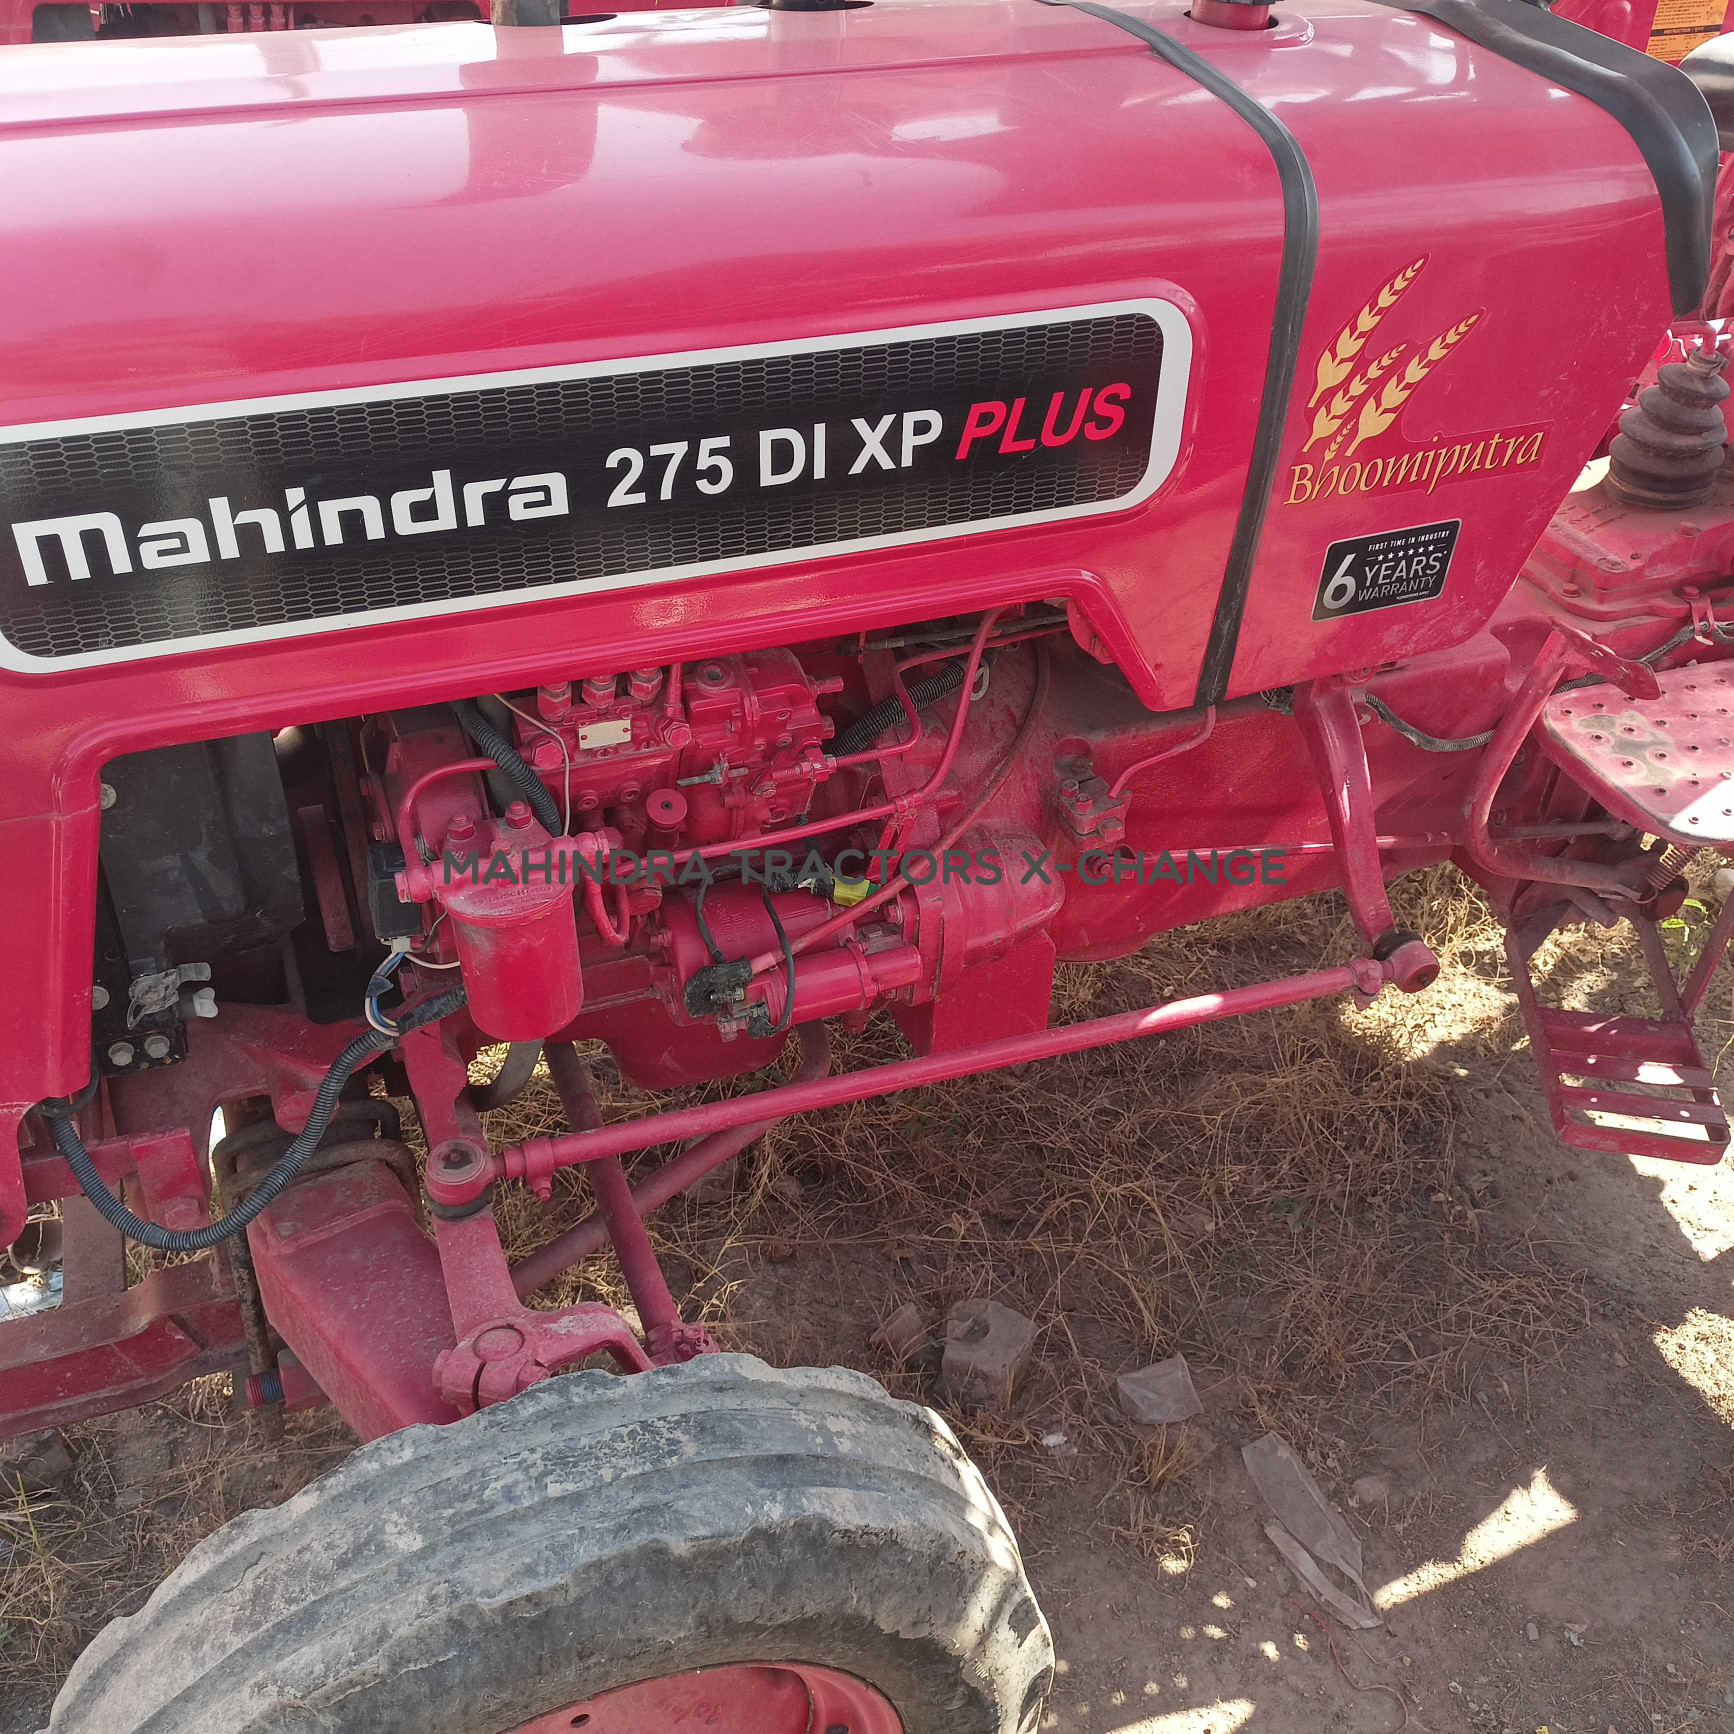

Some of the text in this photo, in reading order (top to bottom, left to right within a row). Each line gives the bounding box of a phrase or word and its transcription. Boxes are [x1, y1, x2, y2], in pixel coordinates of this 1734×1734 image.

[11, 382, 1132, 587] mahindra 275 DI XP PLUS
[1283, 430, 1545, 506] Bhoomiputra
[1368, 530, 1450, 552] FIRST TIME IN INDUSTRY
[1323, 552, 1357, 610] 6
[1358, 575, 1438, 602] WARRANTY
